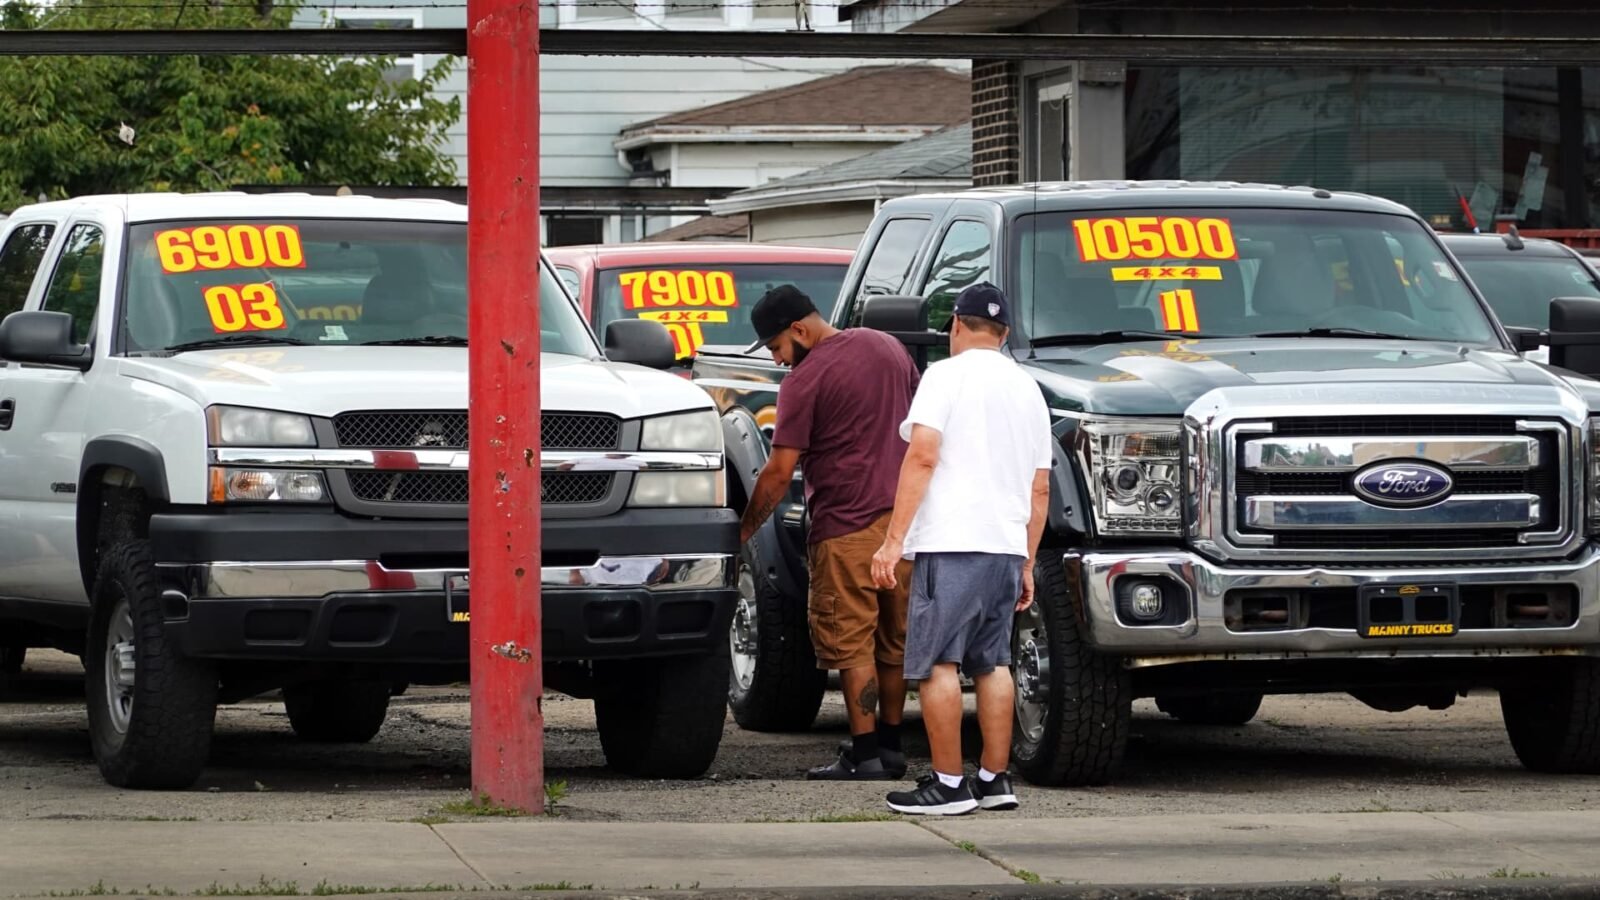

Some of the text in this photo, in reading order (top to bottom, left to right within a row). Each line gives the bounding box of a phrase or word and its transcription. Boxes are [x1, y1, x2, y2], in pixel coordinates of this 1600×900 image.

[155, 224, 303, 272] 6900
[1073, 216, 1236, 260] 10500
[204, 281, 284, 331] 03
[618, 270, 736, 307] 7900
[1159, 288, 1199, 332] 11
[1378, 470, 1431, 493] Ford
[1368, 624, 1454, 636] MANNY TRUCKS
